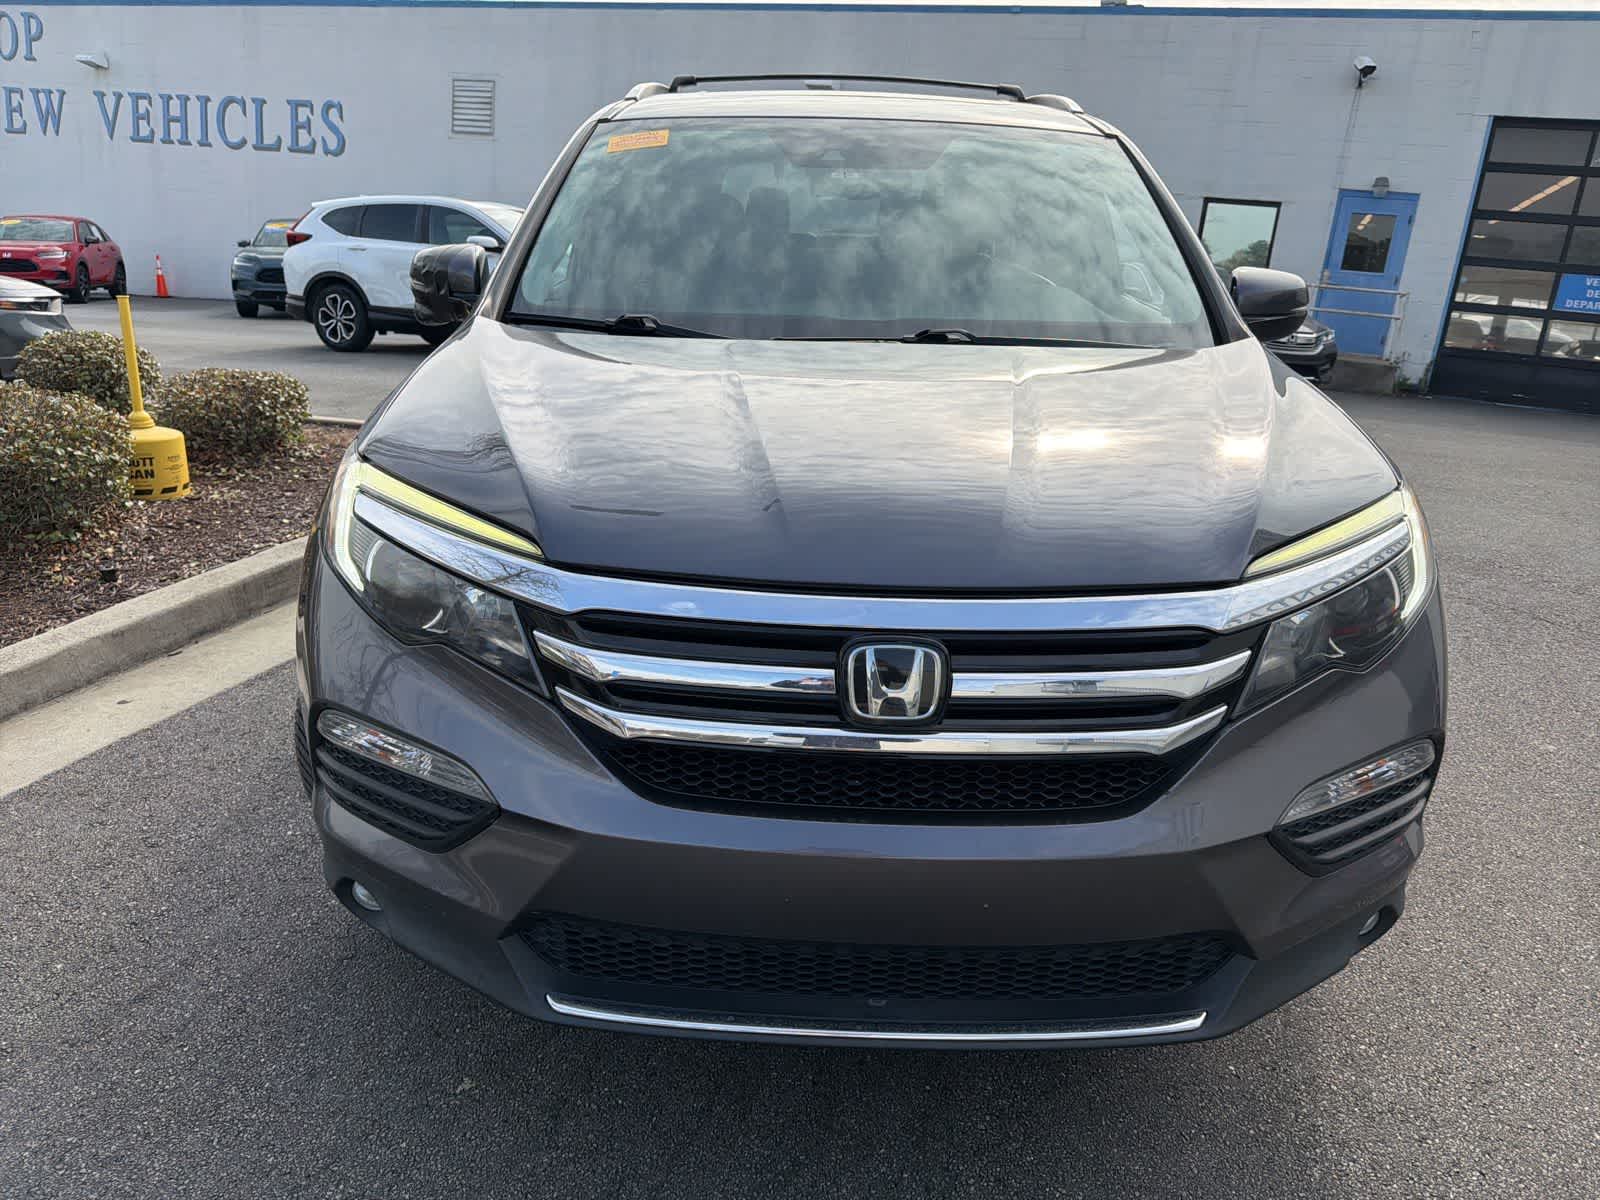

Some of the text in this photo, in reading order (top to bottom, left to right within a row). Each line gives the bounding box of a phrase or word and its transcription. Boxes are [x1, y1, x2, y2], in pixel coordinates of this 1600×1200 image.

[2, 87, 346, 157] EW VEHICLES
[129, 456, 155, 467] UTT
